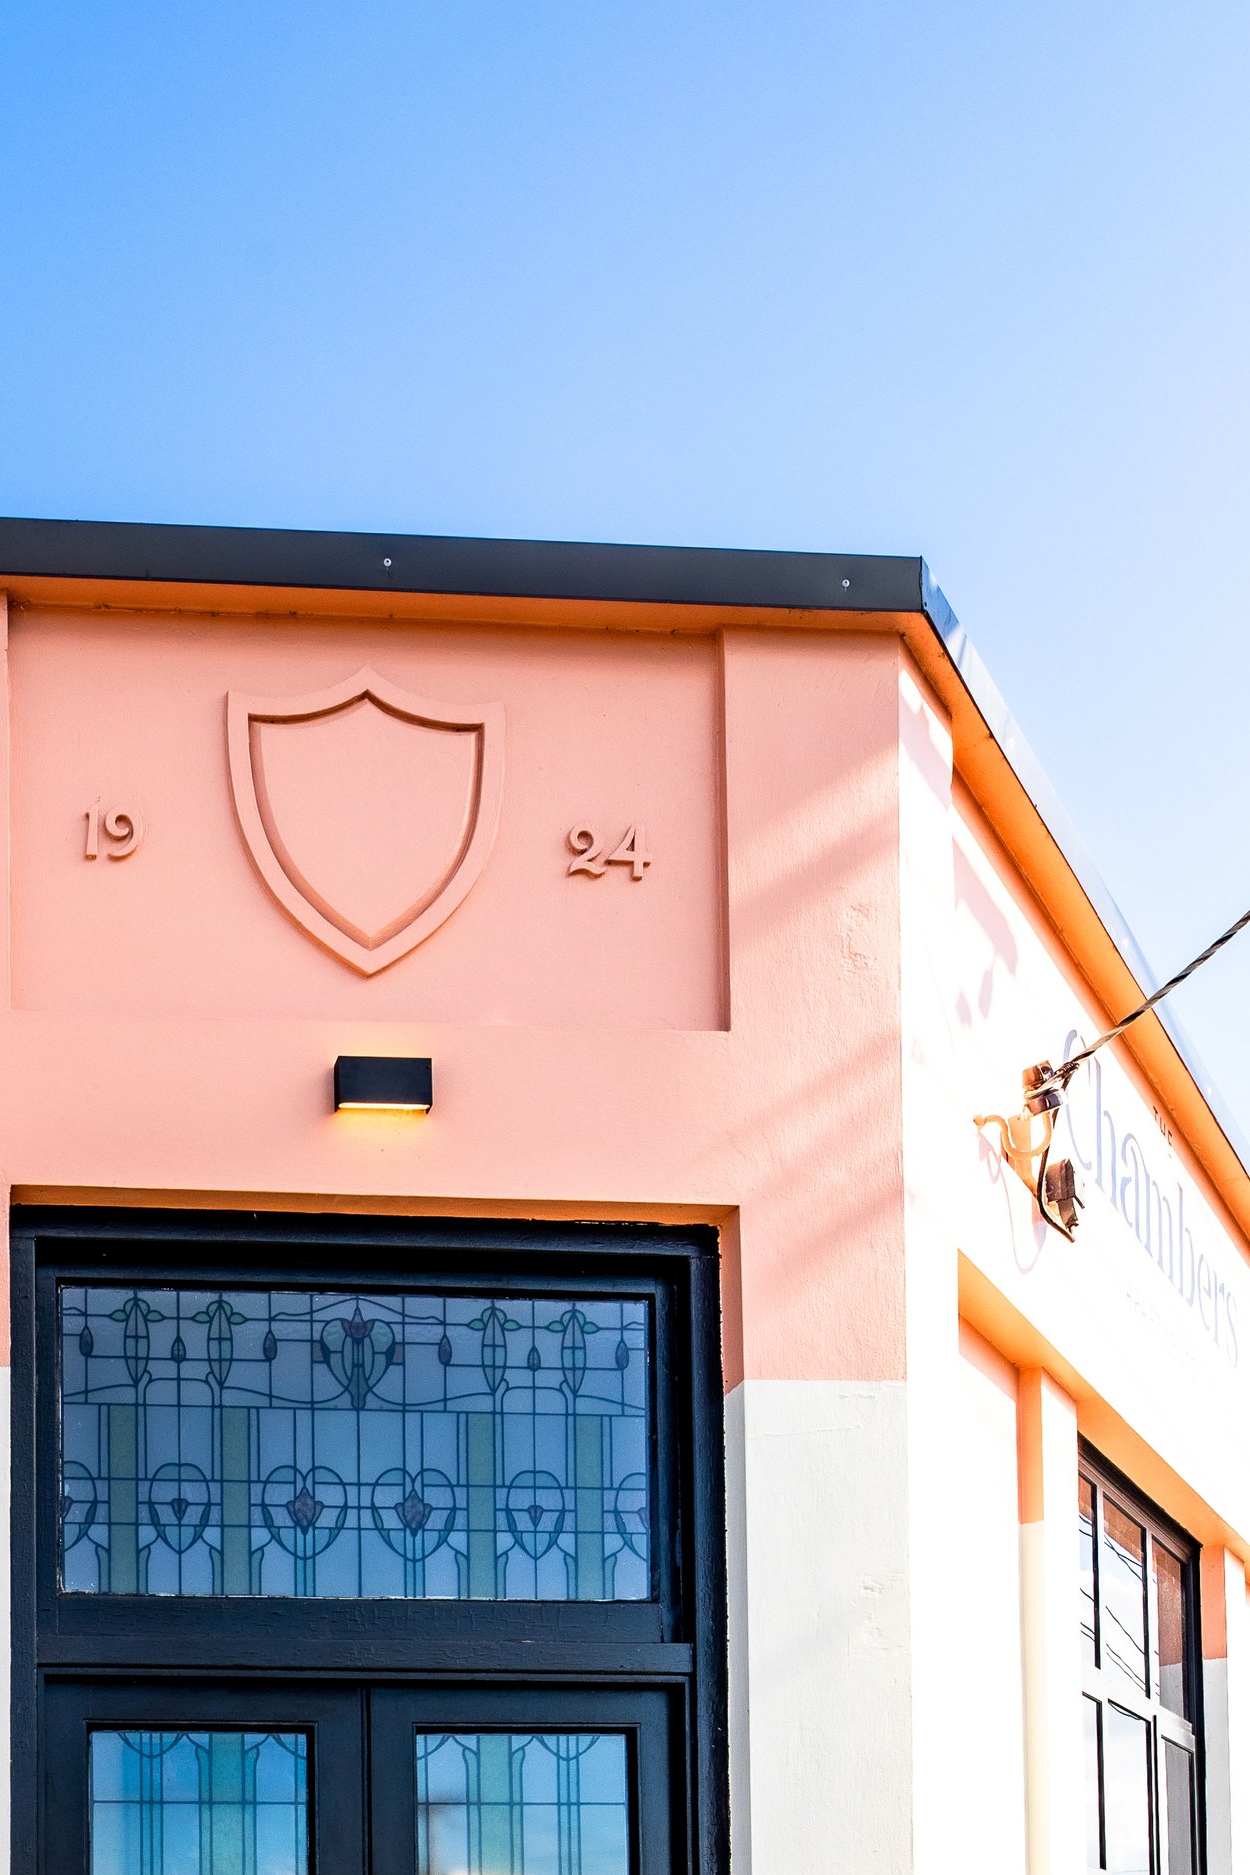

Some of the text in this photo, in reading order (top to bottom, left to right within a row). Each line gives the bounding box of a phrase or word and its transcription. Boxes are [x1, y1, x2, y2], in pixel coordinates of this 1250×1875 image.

[84, 804, 144, 861] 19
[566, 823, 650, 882] 24
[1061, 1028, 1240, 1369] Chambers
